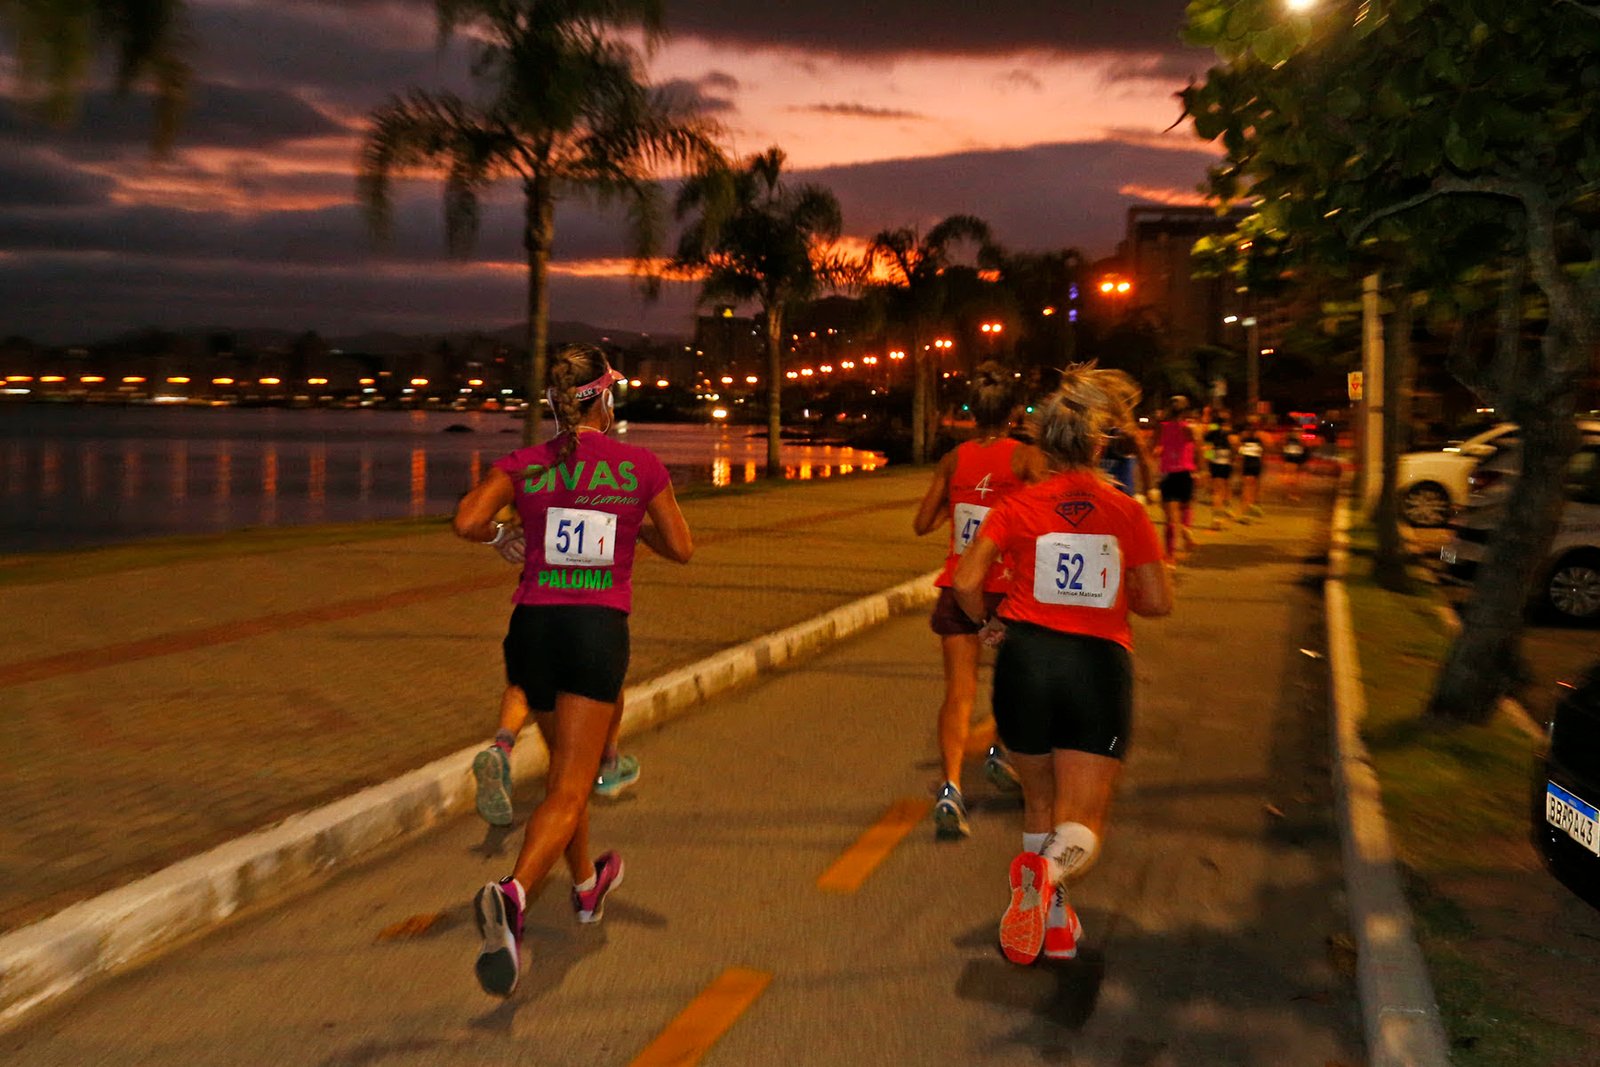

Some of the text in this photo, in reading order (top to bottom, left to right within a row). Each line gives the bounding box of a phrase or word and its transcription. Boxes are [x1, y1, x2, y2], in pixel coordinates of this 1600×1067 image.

[523, 461, 638, 493] DIVAS
[556, 519, 585, 554] 51
[598, 536, 604, 555] 1
[538, 569, 613, 589] PALOMA
[1055, 552, 1084, 590] 52
[1101, 567, 1107, 589] 1
